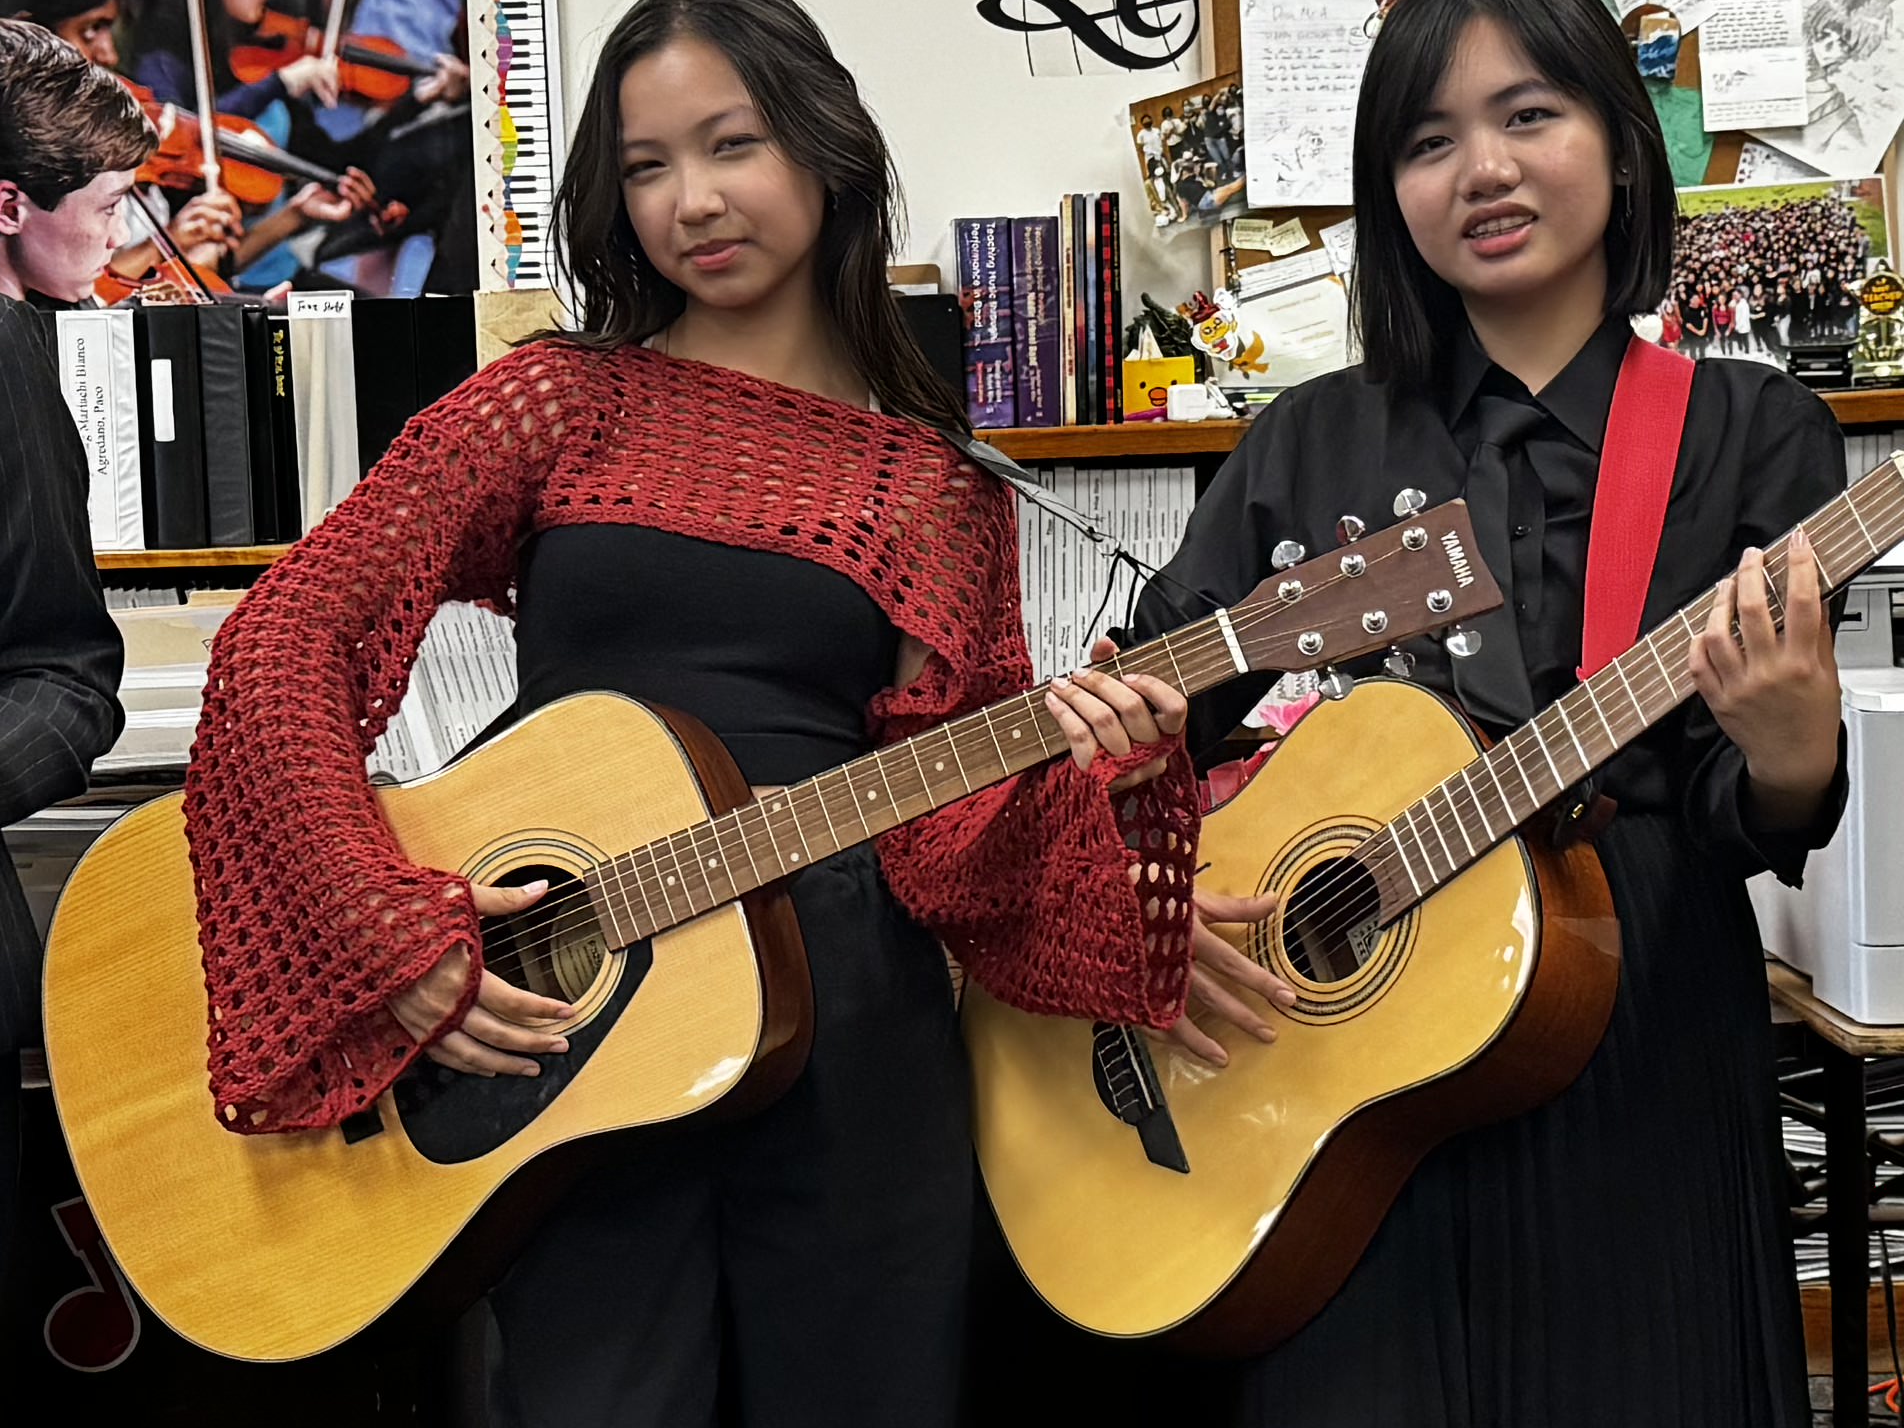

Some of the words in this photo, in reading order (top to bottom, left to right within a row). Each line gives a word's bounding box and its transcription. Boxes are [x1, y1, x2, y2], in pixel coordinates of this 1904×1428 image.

[969, 223, 981, 286] Performance
[985, 222, 997, 268] Teaching
[988, 271, 998, 299] Music
[973, 301, 983, 328] Band
[75, 338, 87, 377] Blanco
[75, 381, 90, 432] Mariachi
[93, 386, 105, 413] Paco
[1441, 530, 1474, 588] YAMAHA
